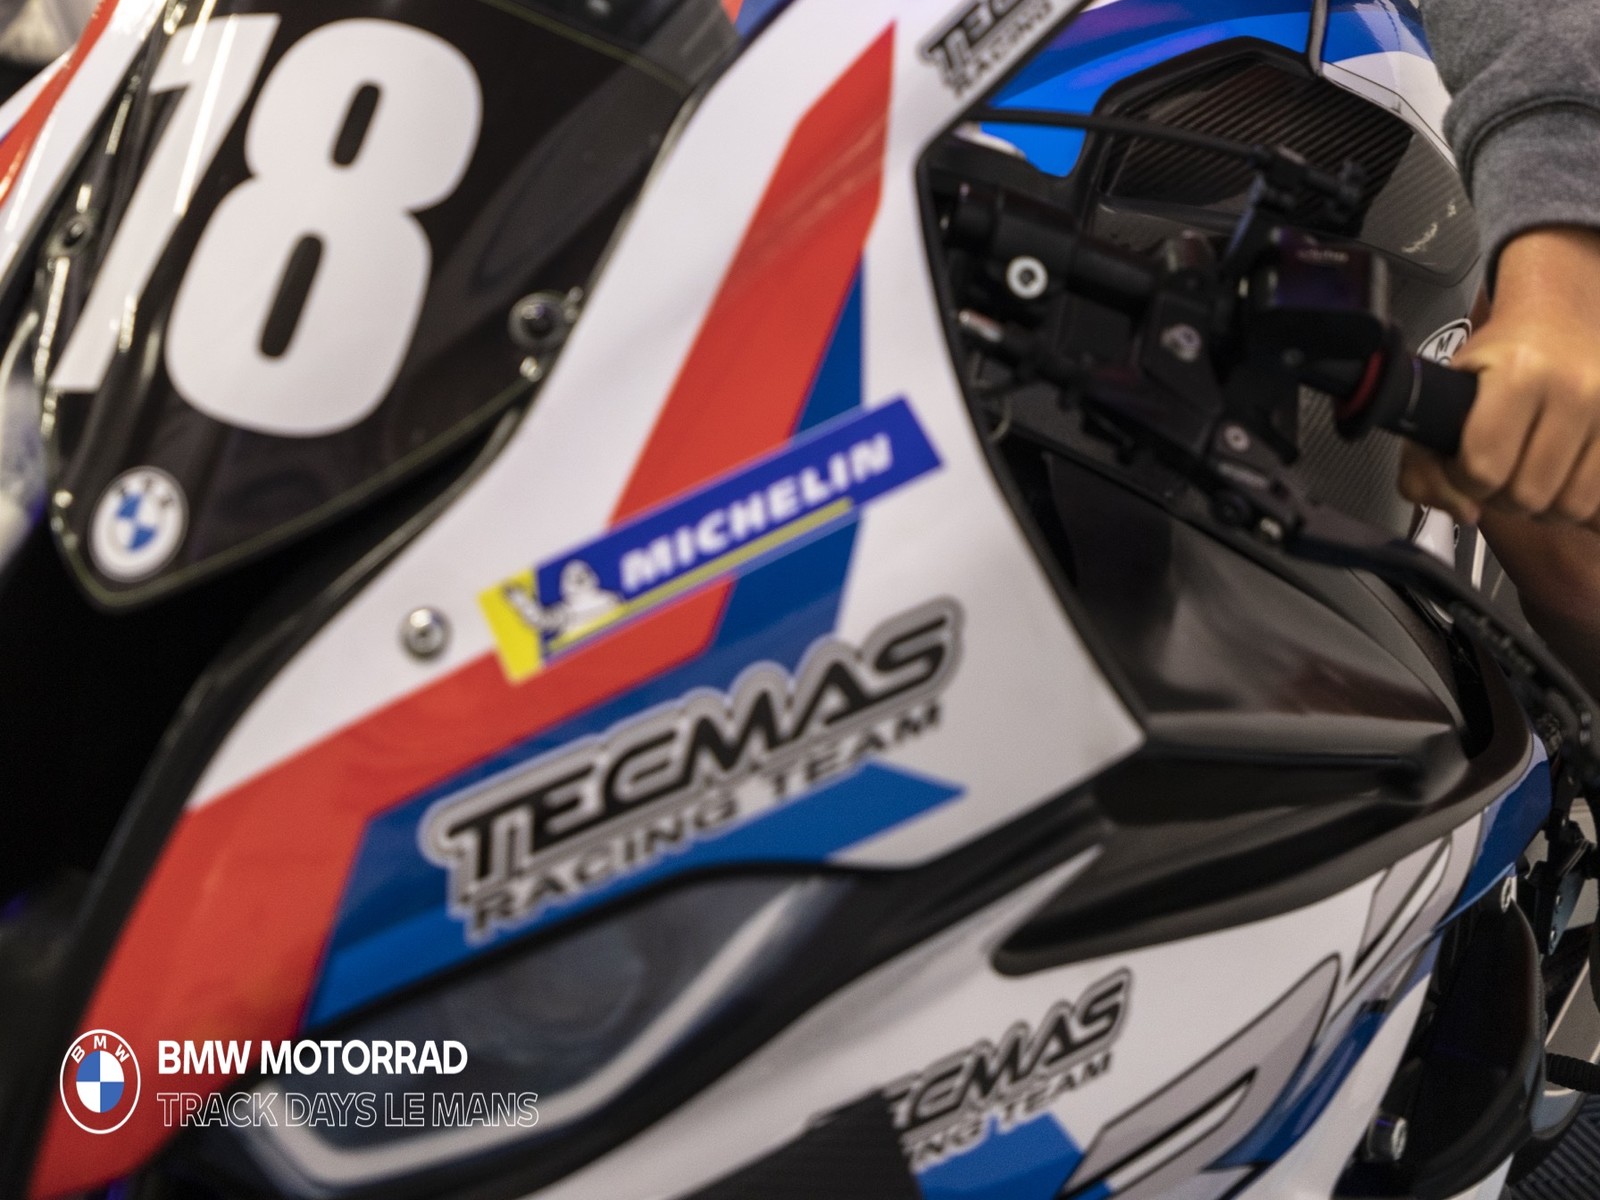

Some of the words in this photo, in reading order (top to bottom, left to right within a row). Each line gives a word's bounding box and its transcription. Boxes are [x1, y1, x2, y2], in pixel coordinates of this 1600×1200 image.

[619, 431, 893, 593] MICHELIN
[445, 613, 950, 882] TECMAS
[472, 788, 740, 938] RACING
[768, 702, 946, 798] TEAM
